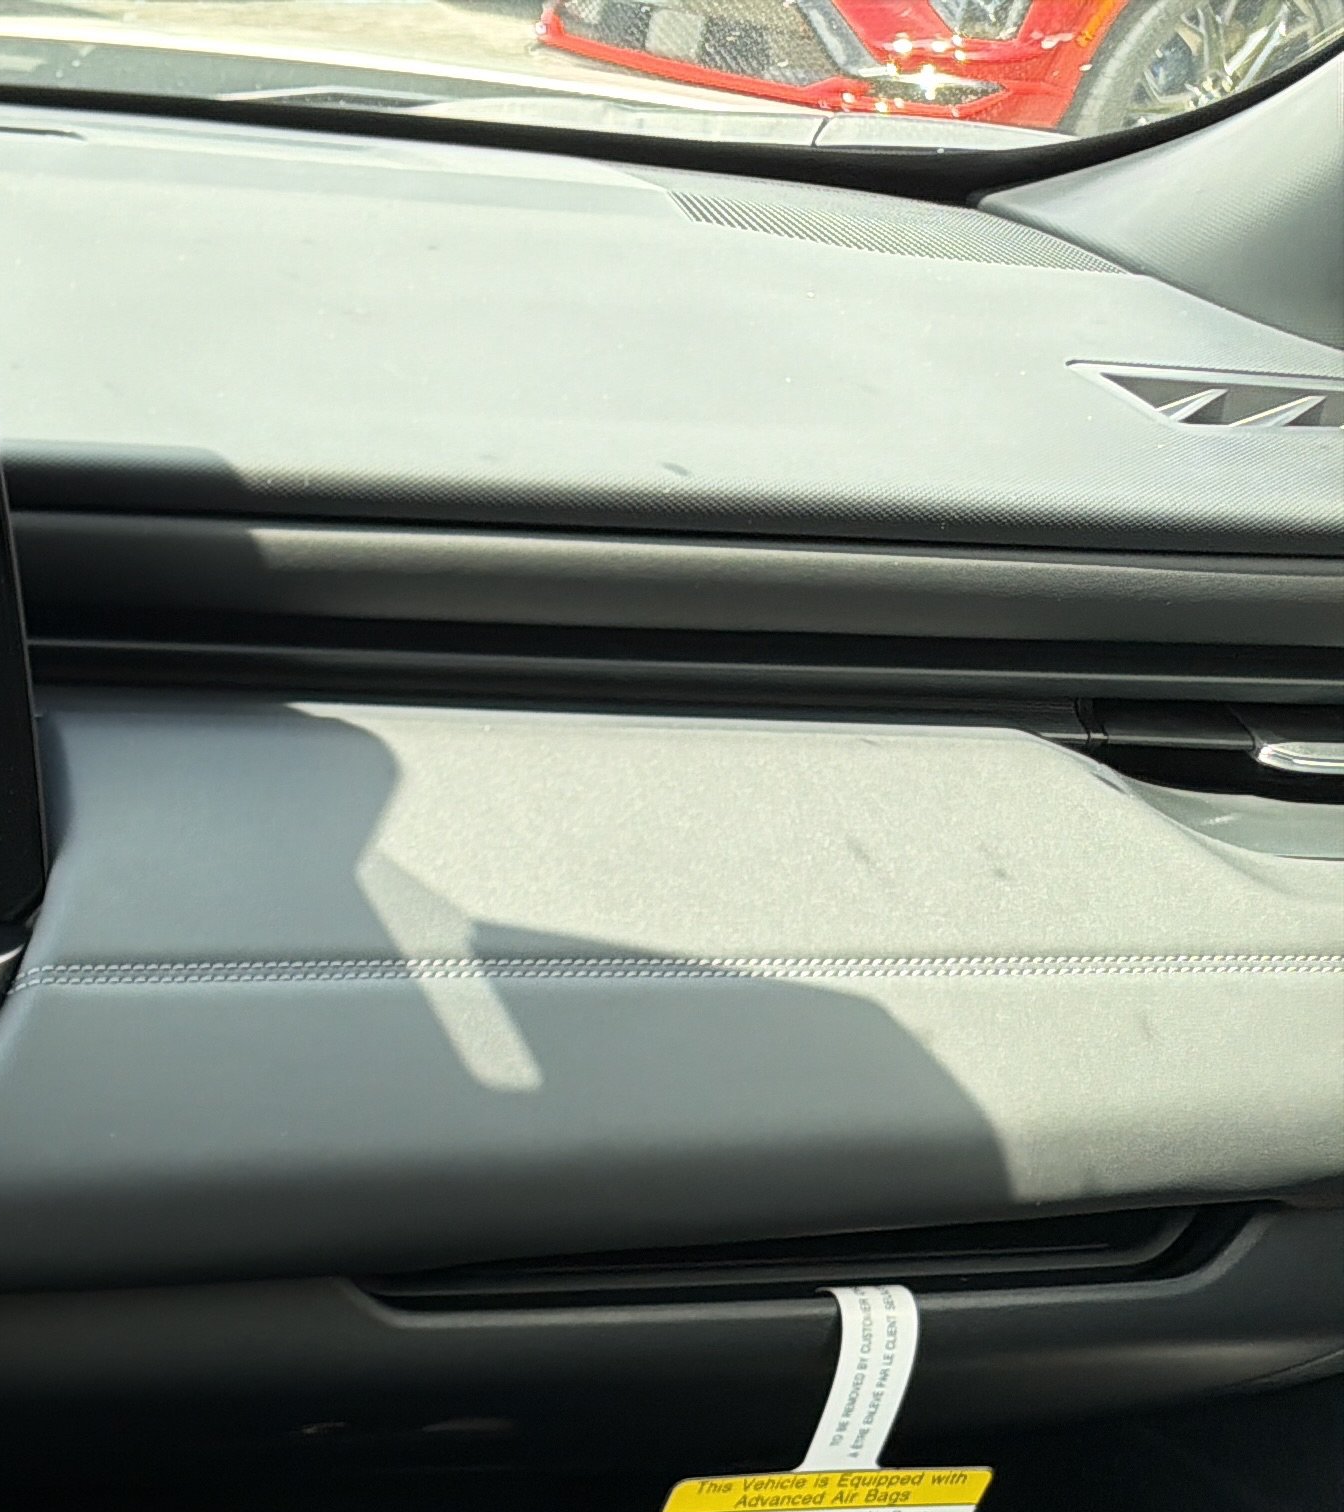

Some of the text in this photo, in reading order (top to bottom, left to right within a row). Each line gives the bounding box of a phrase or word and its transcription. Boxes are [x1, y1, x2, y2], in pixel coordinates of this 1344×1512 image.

[696, 1470, 968, 1495] This Vehicle is Equipped with
[734, 1488, 912, 1509] Advanced Air Bags
